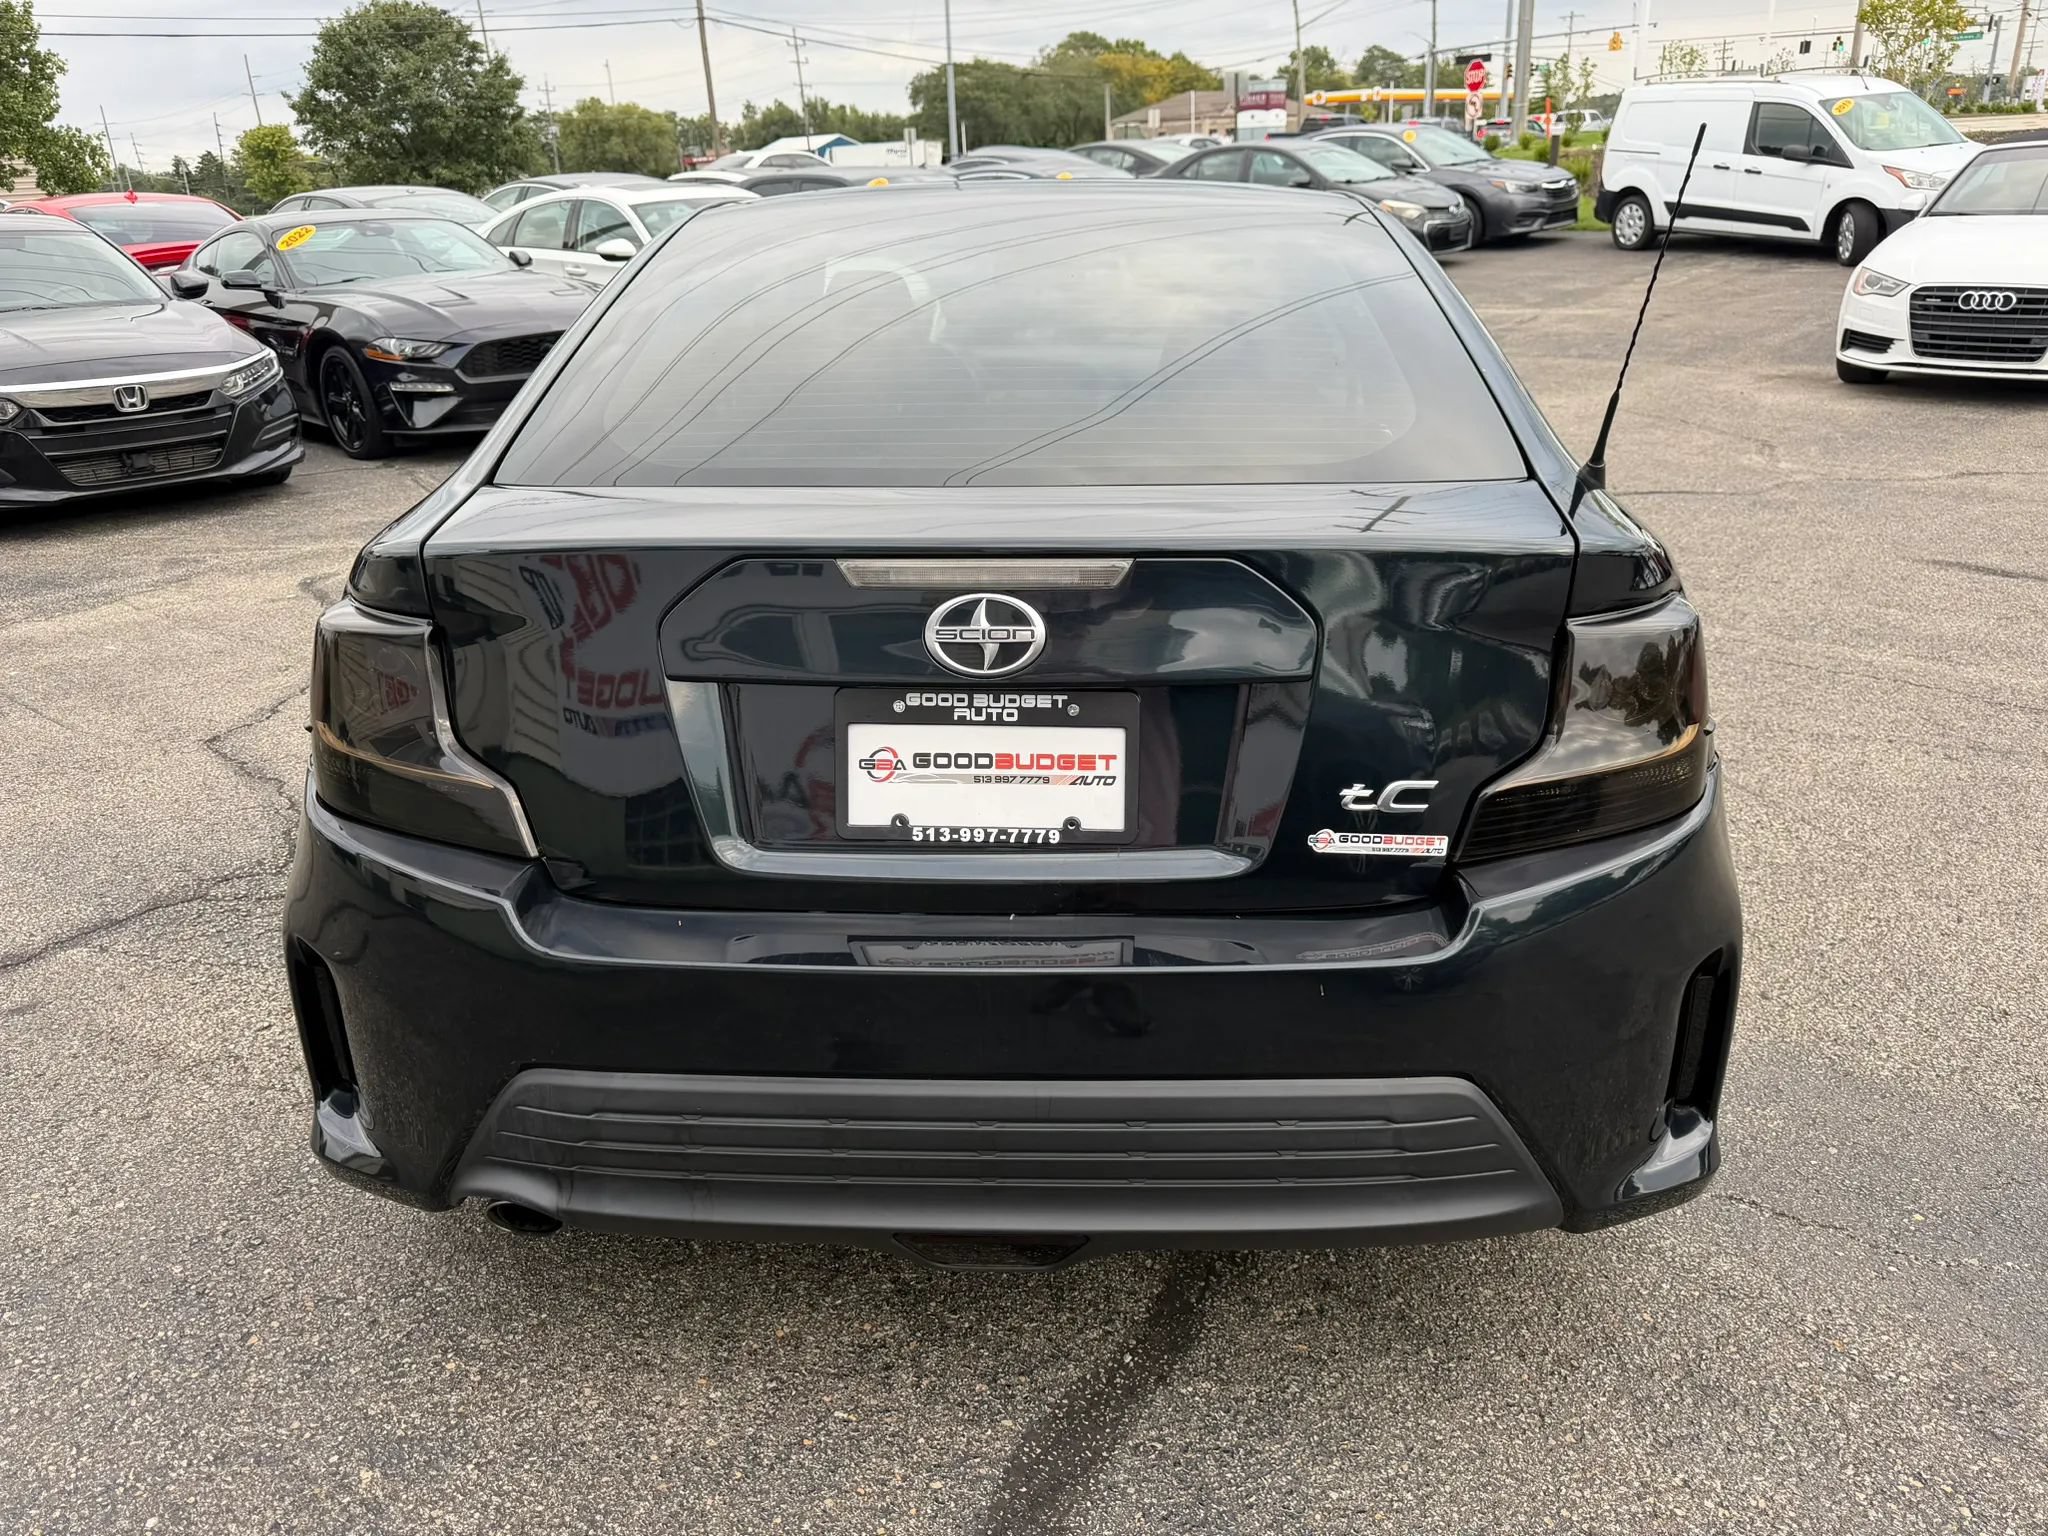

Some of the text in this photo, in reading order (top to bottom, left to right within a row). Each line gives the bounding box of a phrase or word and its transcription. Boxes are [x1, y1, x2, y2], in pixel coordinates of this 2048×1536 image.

[1466, 69, 1484, 84] STOP
[280, 227, 312, 247] 2022
[935, 628, 1036, 641] SCION
[905, 692, 1069, 708] GOOD BUDGET
[953, 707, 1019, 722] AUTO
[858, 752, 1118, 771] GBA GOODBUDGET
[973, 775, 1117, 787] 513 997 7779 AUTO
[1339, 780, 1440, 813] tC
[911, 826, 1061, 845] 513-997-7779
[1338, 834, 1447, 847] GOODBUDGET
